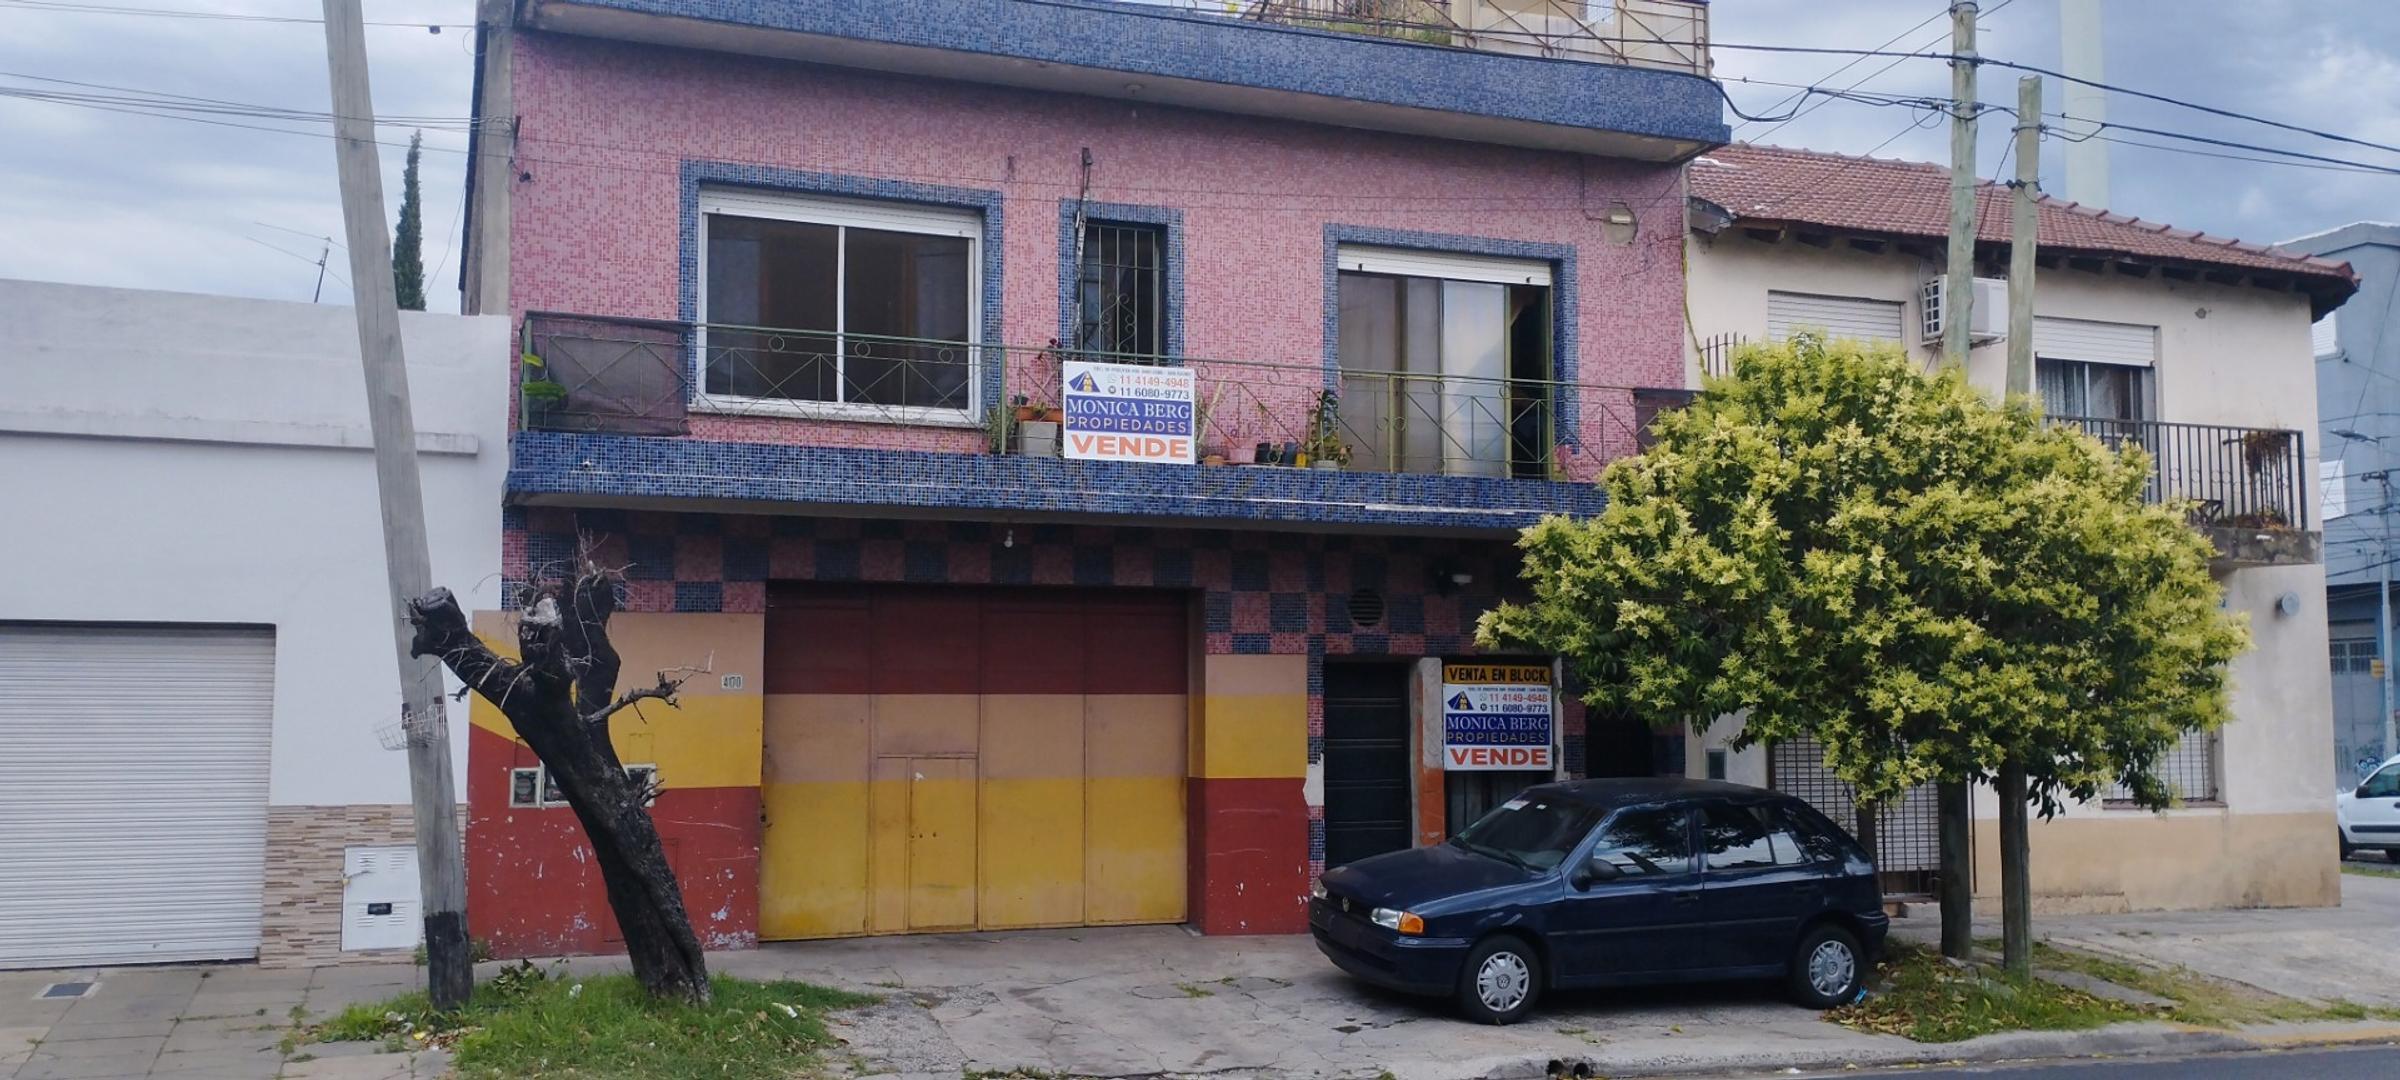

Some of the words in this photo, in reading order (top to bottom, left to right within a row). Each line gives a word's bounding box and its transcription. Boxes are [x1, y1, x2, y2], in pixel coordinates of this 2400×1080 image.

[1120, 375, 1130, 385] 11
[1135, 376, 1189, 388] 4149-4948
[1120, 387, 1130, 397] 11
[1135, 388, 1189, 400] 6080-9773
[1068, 398, 1139, 417] MONICA
[1144, 402, 1189, 419] BERG
[1067, 416, 1187, 433] PROPIEDADES
[1071, 434, 1188, 458] VENDE
[1449, 667, 1487, 681] VENTA
[1492, 668, 1506, 681] EN
[1511, 668, 1547, 682] BLOCK
[1489, 693, 1499, 702] 11
[1489, 704, 1499, 712] 11
[1502, 704, 1548, 713] 6080-9773
[1448, 716, 1506, 730] MONICA
[1510, 717, 1548, 730] BERG
[1448, 731, 1545, 743] PROPIEDADES
[1450, 748, 1548, 765] VENDE
